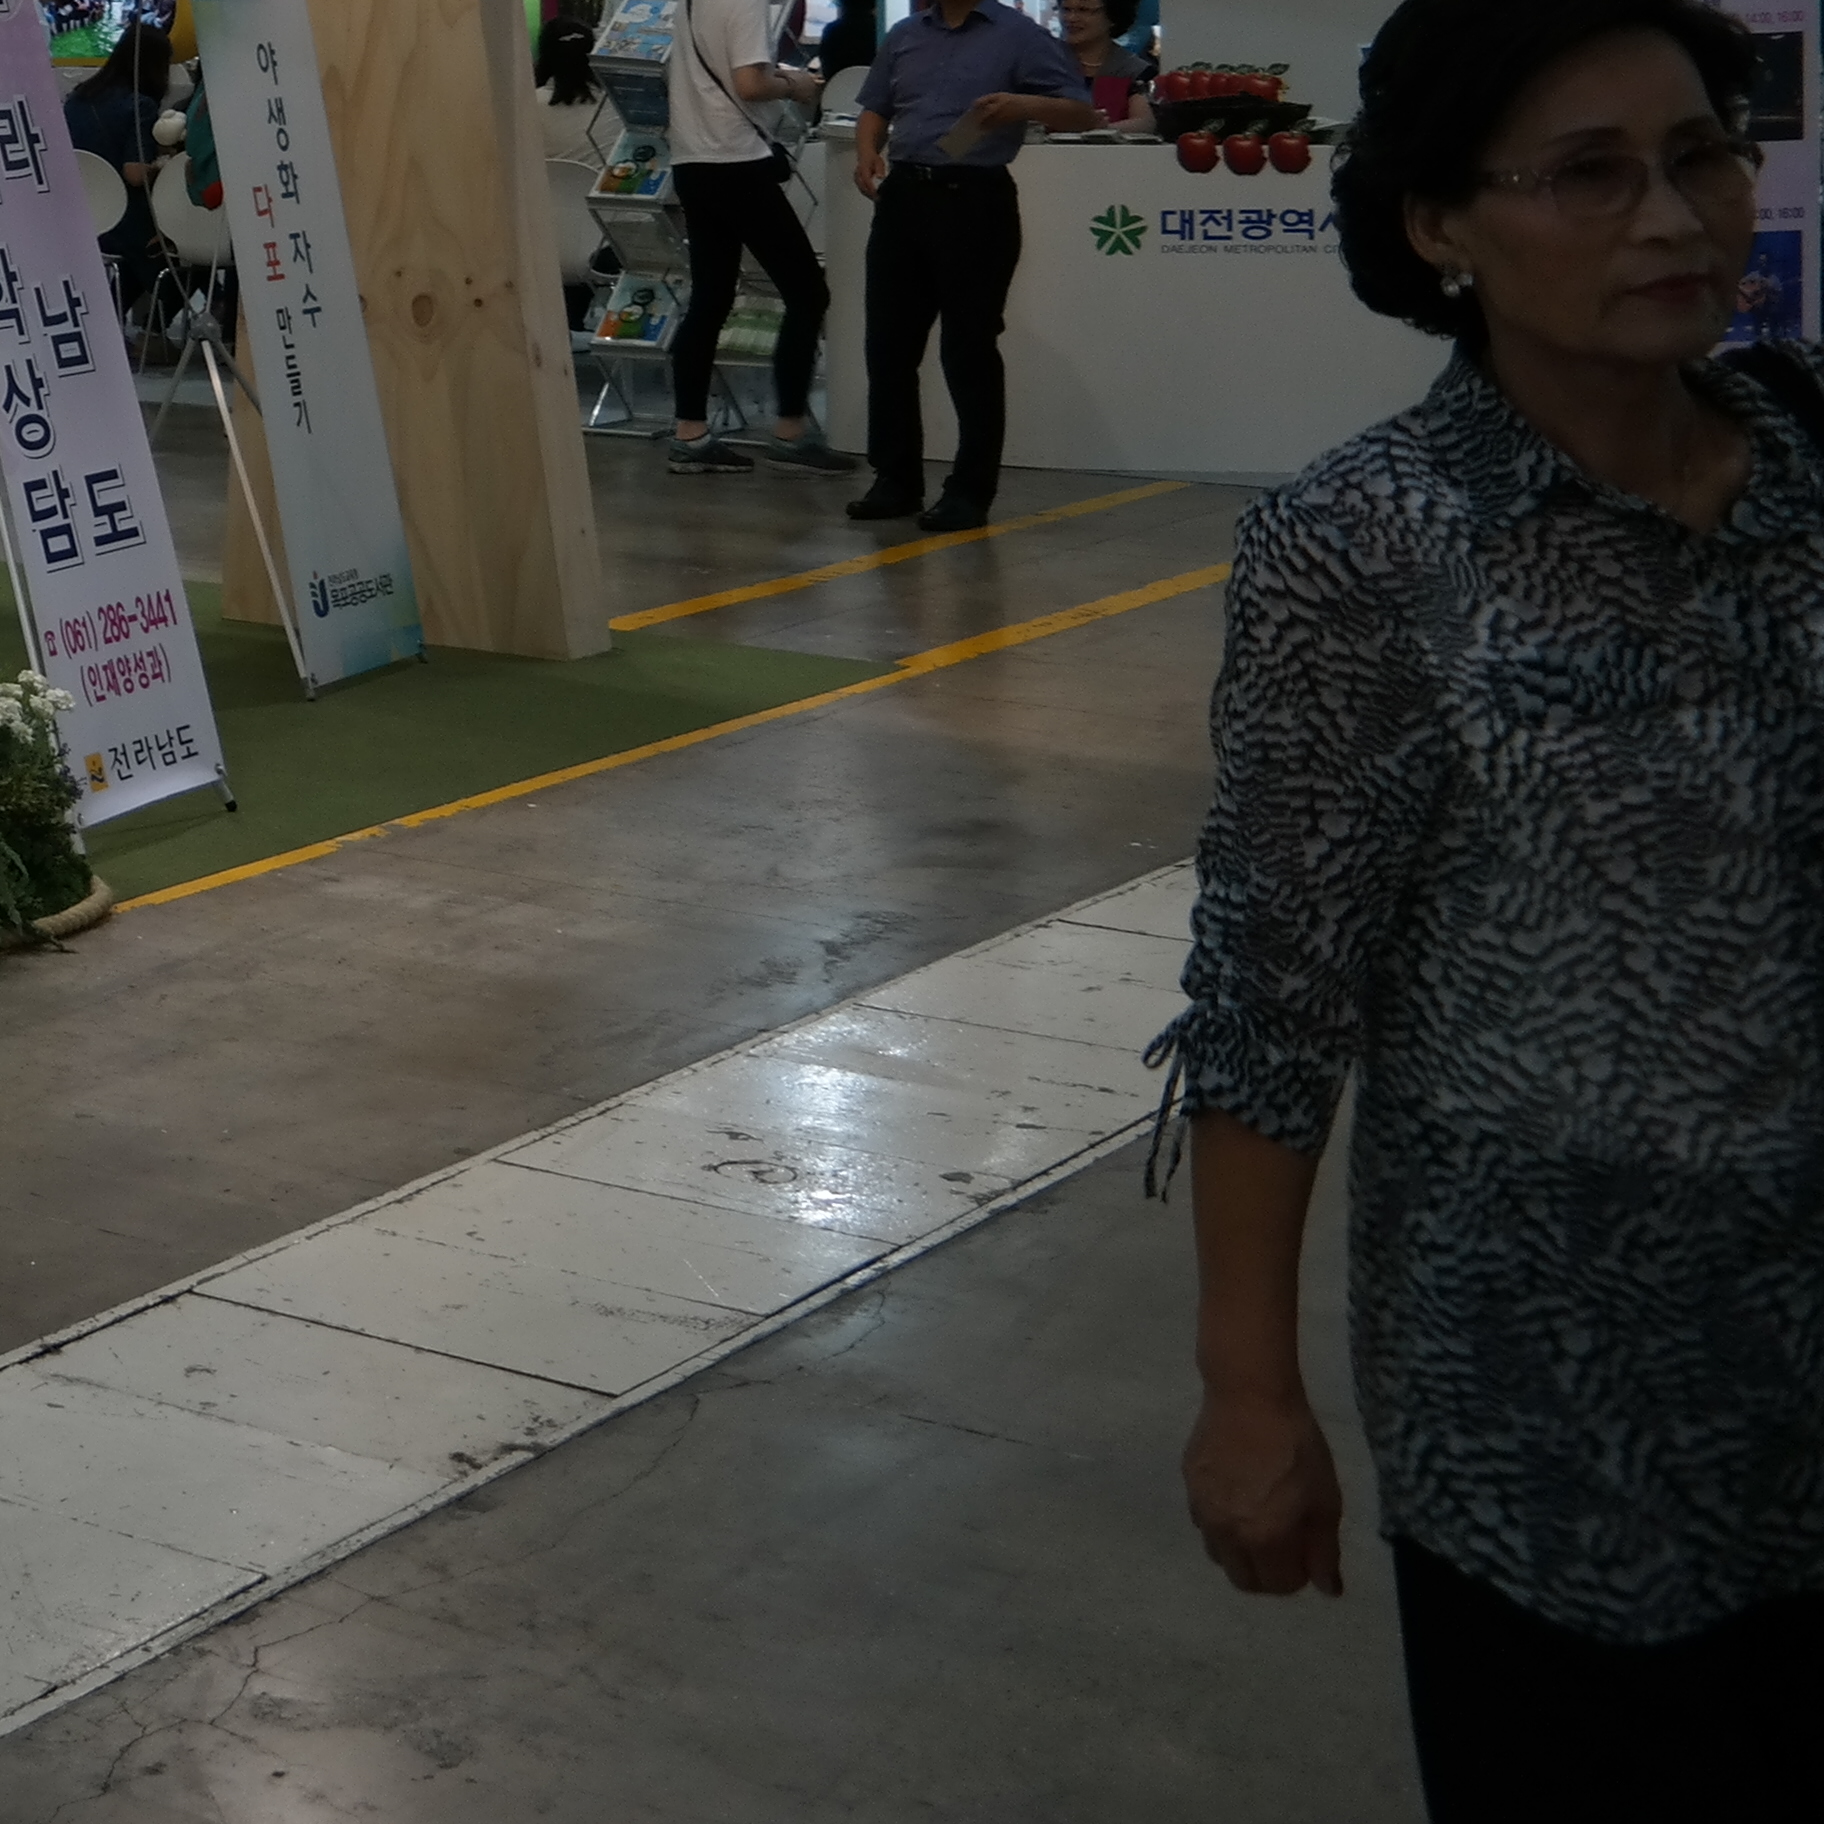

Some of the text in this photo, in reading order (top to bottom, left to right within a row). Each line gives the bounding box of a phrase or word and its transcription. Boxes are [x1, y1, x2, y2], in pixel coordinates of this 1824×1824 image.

[256, 41, 300, 205] 야생화
[1161, 244, 1218, 255] DAEJEON
[97, 587, 179, 646] 286-3441
[107, 723, 201, 782] 전라남도
